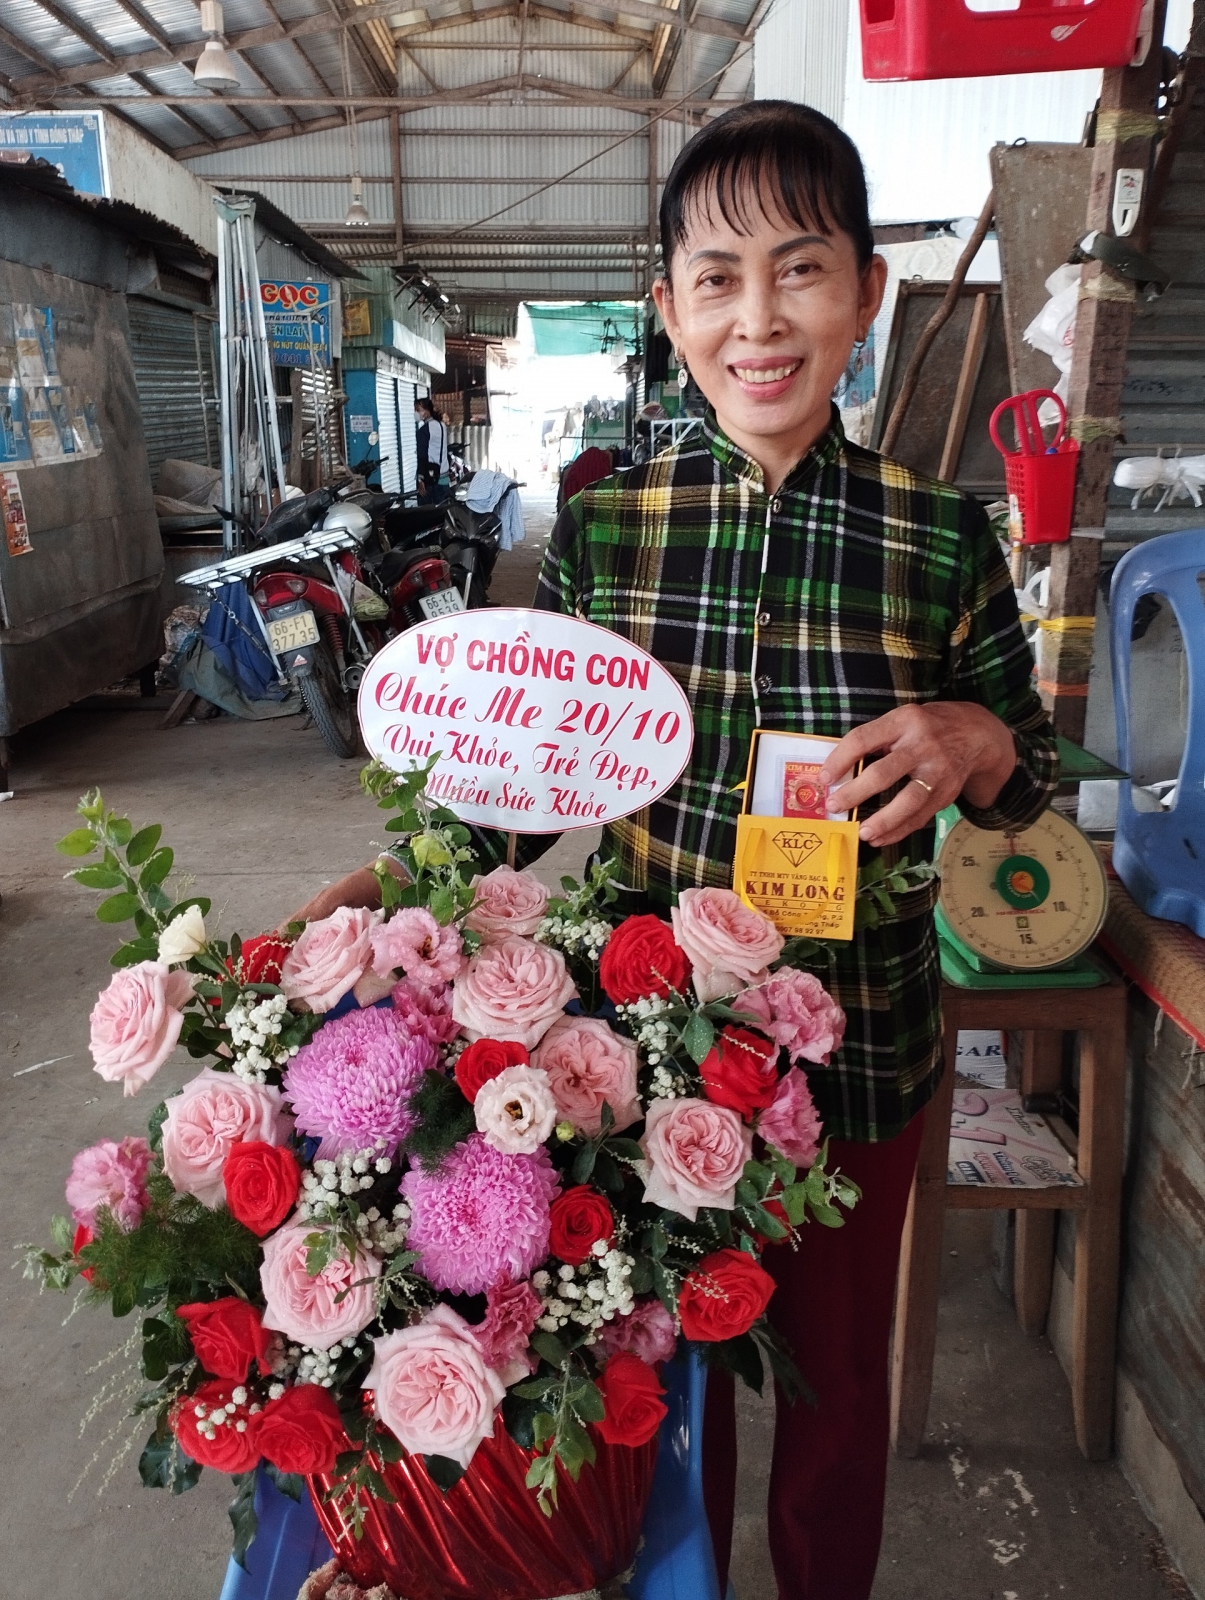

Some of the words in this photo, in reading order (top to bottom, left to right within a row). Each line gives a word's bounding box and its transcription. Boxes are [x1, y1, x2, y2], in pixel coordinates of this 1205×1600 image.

[273, 615, 307, 636] 66-F1
[416, 632, 459, 674] VỢ
[466, 630, 576, 683] CHỒNG
[585, 653, 651, 691] CON
[374, 671, 467, 720] Chúc
[554, 698, 680, 747] 20/10
[437, 729, 520, 775] Khỏe,
[532, 741, 581, 778] Trẻ
[589, 748, 657, 792] Đẹp,
[495, 781, 537, 812] Sức
[541, 786, 608, 819] Khỏe
[781, 837, 815, 850] KLC
[745, 880, 785, 897] KIM
[791, 883, 845, 901] LONG
[791, 872, 807, 880] VÀNG
